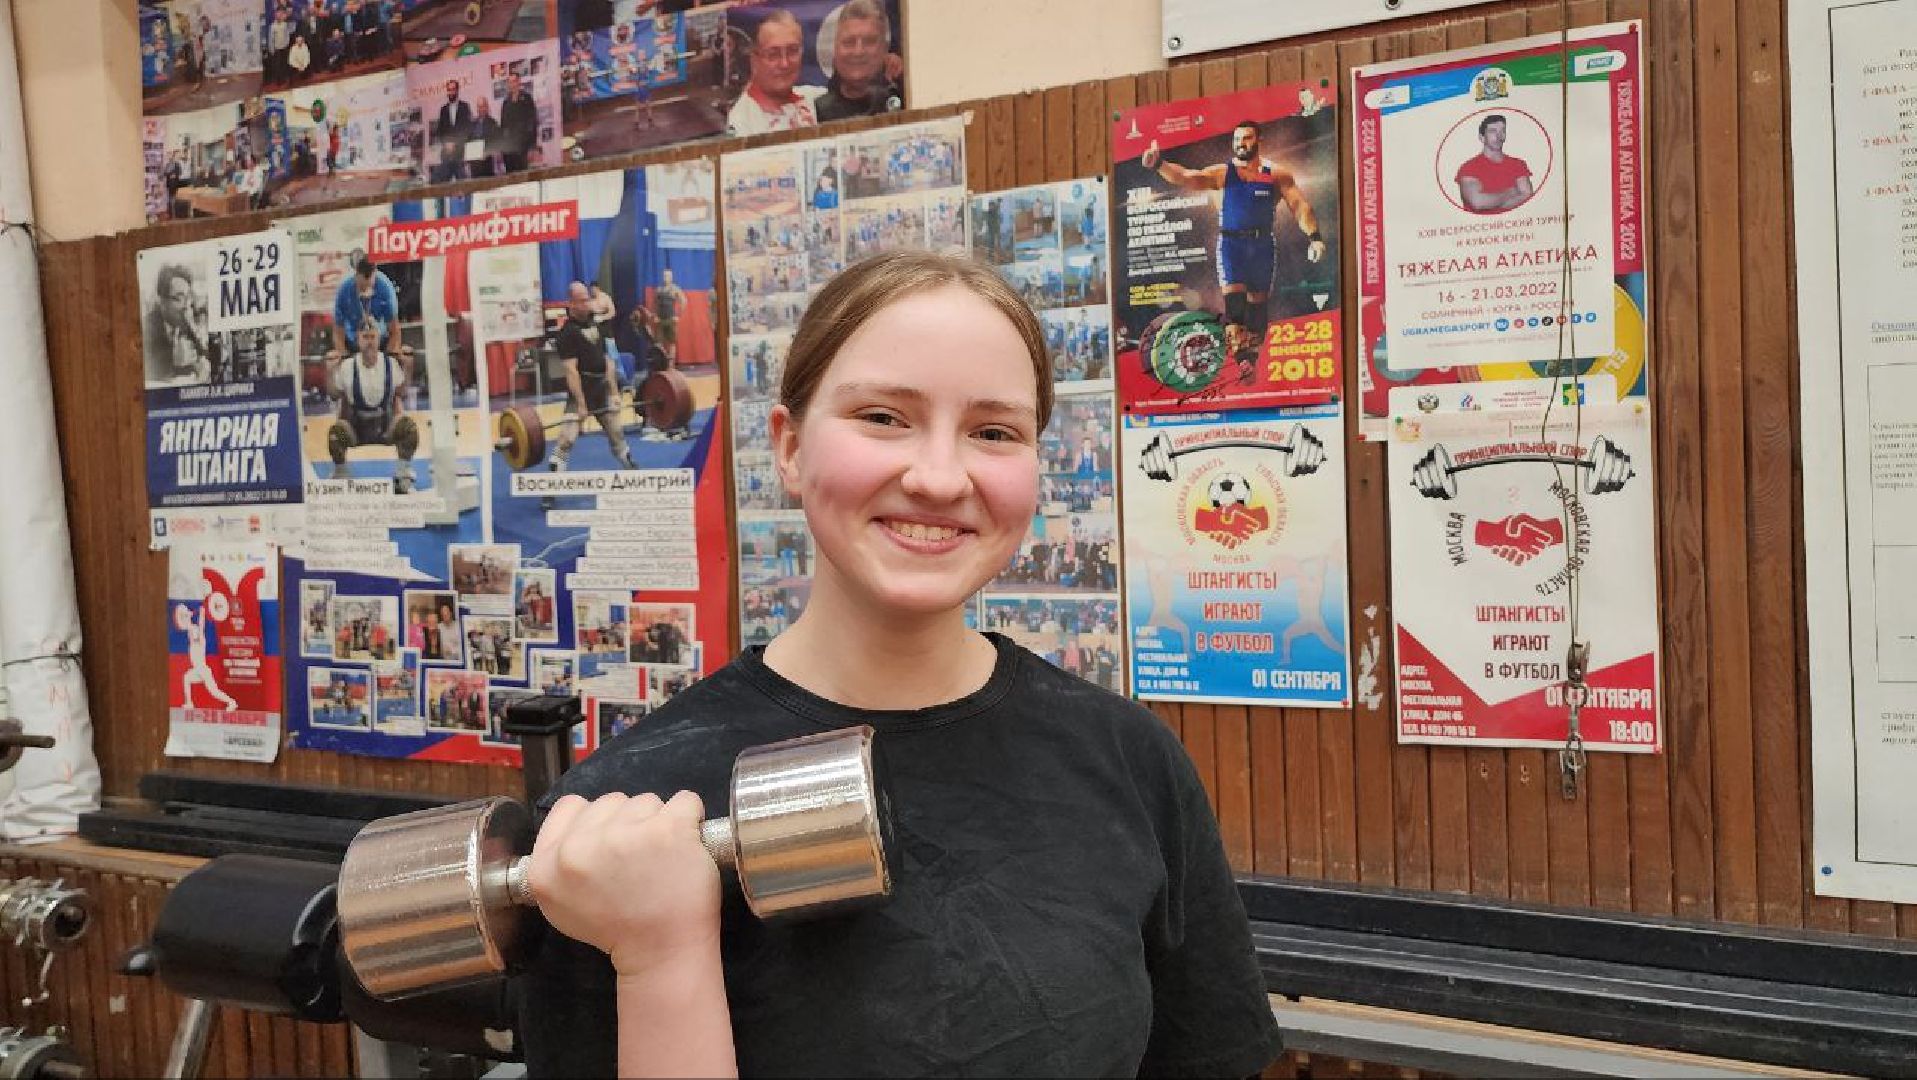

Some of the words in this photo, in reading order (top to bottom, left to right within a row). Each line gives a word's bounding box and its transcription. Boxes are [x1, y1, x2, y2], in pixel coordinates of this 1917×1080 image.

[1362, 118, 1377, 153] 2022
[372, 207, 571, 258] Пауэрлифтинг
[1439, 217, 1533, 236] ВСЕРОССИЙСКИЙ
[1465, 234, 1500, 248] КУБОК
[1620, 223, 1636, 261] 2022
[219, 242, 279, 275] 26-29
[1397, 255, 1488, 279] ТЯЖЕЛАЯ
[1495, 244, 1598, 269] АТЛЕТИКА
[220, 274, 281, 318] МАЯ
[1438, 290, 1455, 303] 16
[1472, 281, 1557, 300] 21.03.2022
[1269, 320, 1333, 344] 23-28
[1402, 321, 1491, 338] UGRAMEGASPORT
[1269, 343, 1332, 358] января
[1268, 358, 1335, 382] 2018
[160, 413, 280, 454] ЯНТАРНАЯ
[178, 449, 267, 486] ШТАНГА
[611, 470, 691, 492] Дмитрий
[1446, 512, 1467, 566] МОСКВА
[1188, 571, 1277, 590] ШТАНГИСТЫ
[1203, 602, 1262, 622] ИГРАЮТ
[1475, 605, 1566, 622] ШТАНГИСТЫ
[1196, 632, 1206, 653] В
[1210, 632, 1274, 653] ФУТБОЛ
[1493, 634, 1550, 651] ИГРАЮТ
[1252, 669, 1267, 687] 01
[1271, 670, 1341, 690] СЕНТЯБРЯ
[1485, 662, 1493, 680] В
[1499, 662, 1560, 681] ФУТБОЛ
[1545, 686, 1563, 708] 01
[1608, 720, 1654, 742] 18:00
